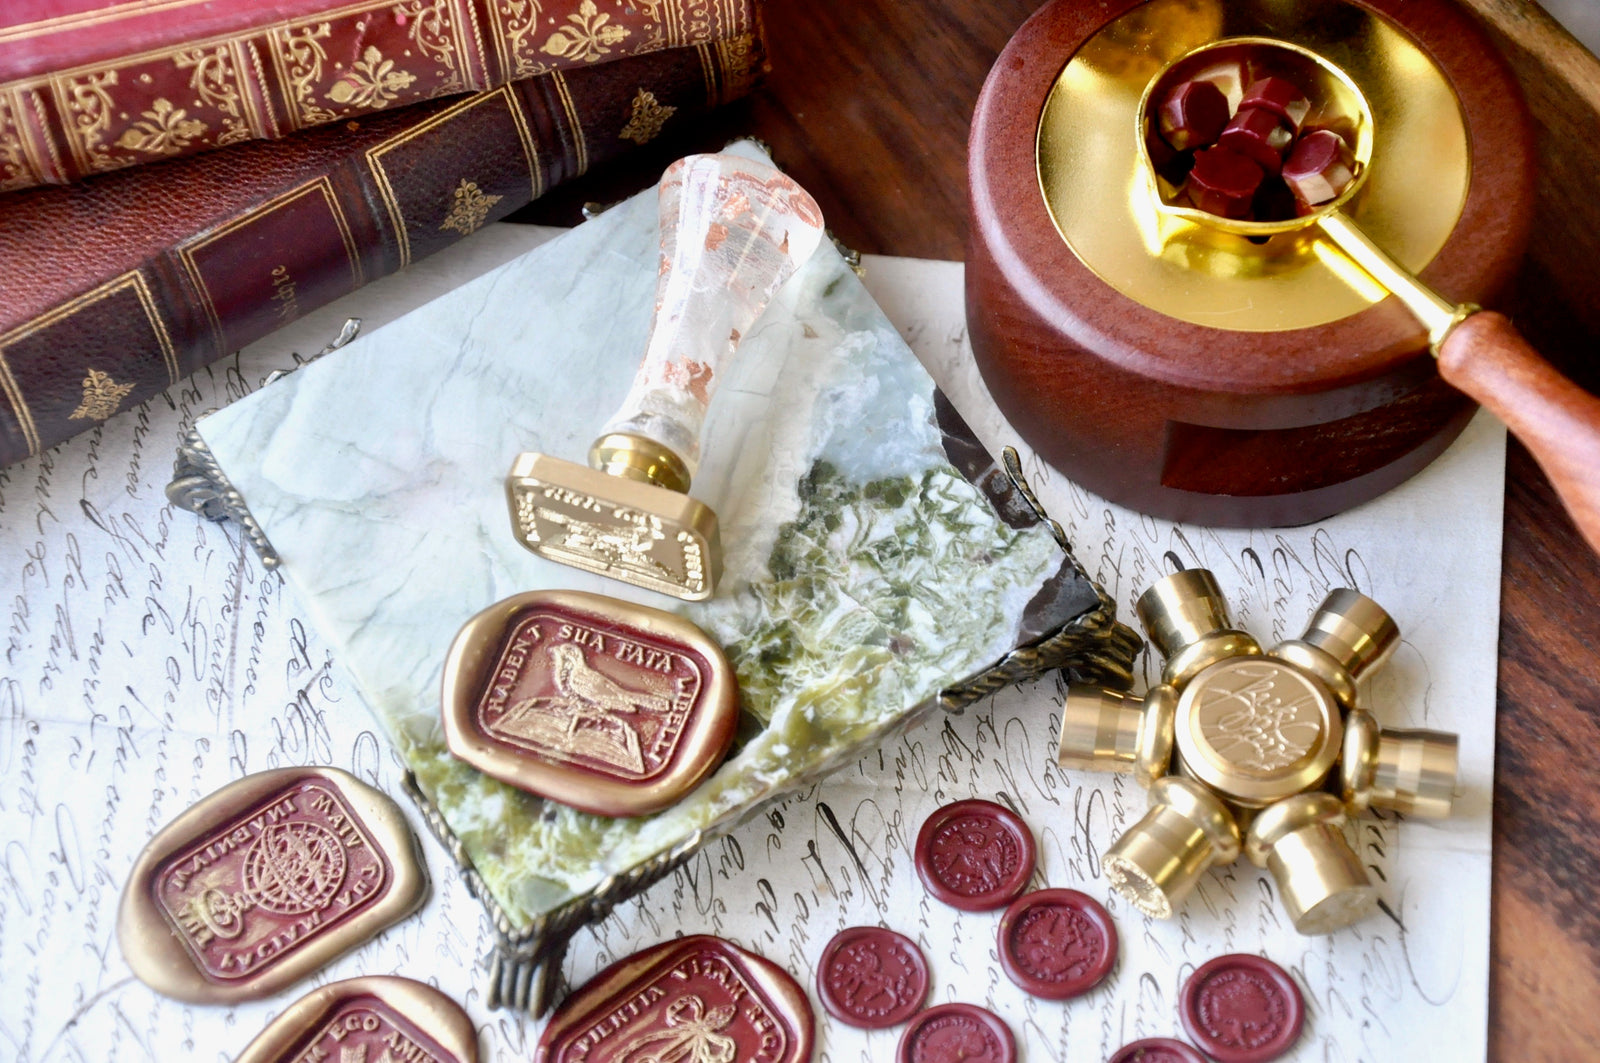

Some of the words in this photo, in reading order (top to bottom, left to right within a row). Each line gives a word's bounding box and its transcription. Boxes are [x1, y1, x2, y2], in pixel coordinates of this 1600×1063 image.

[488, 625, 542, 712] HABENT
[559, 625, 604, 650] SUA
[617, 643, 673, 671] FATA
[651, 676, 695, 762] LIBELLI
[328, 1014, 380, 1042] EGO
[569, 984, 666, 1063] APIENTIA
